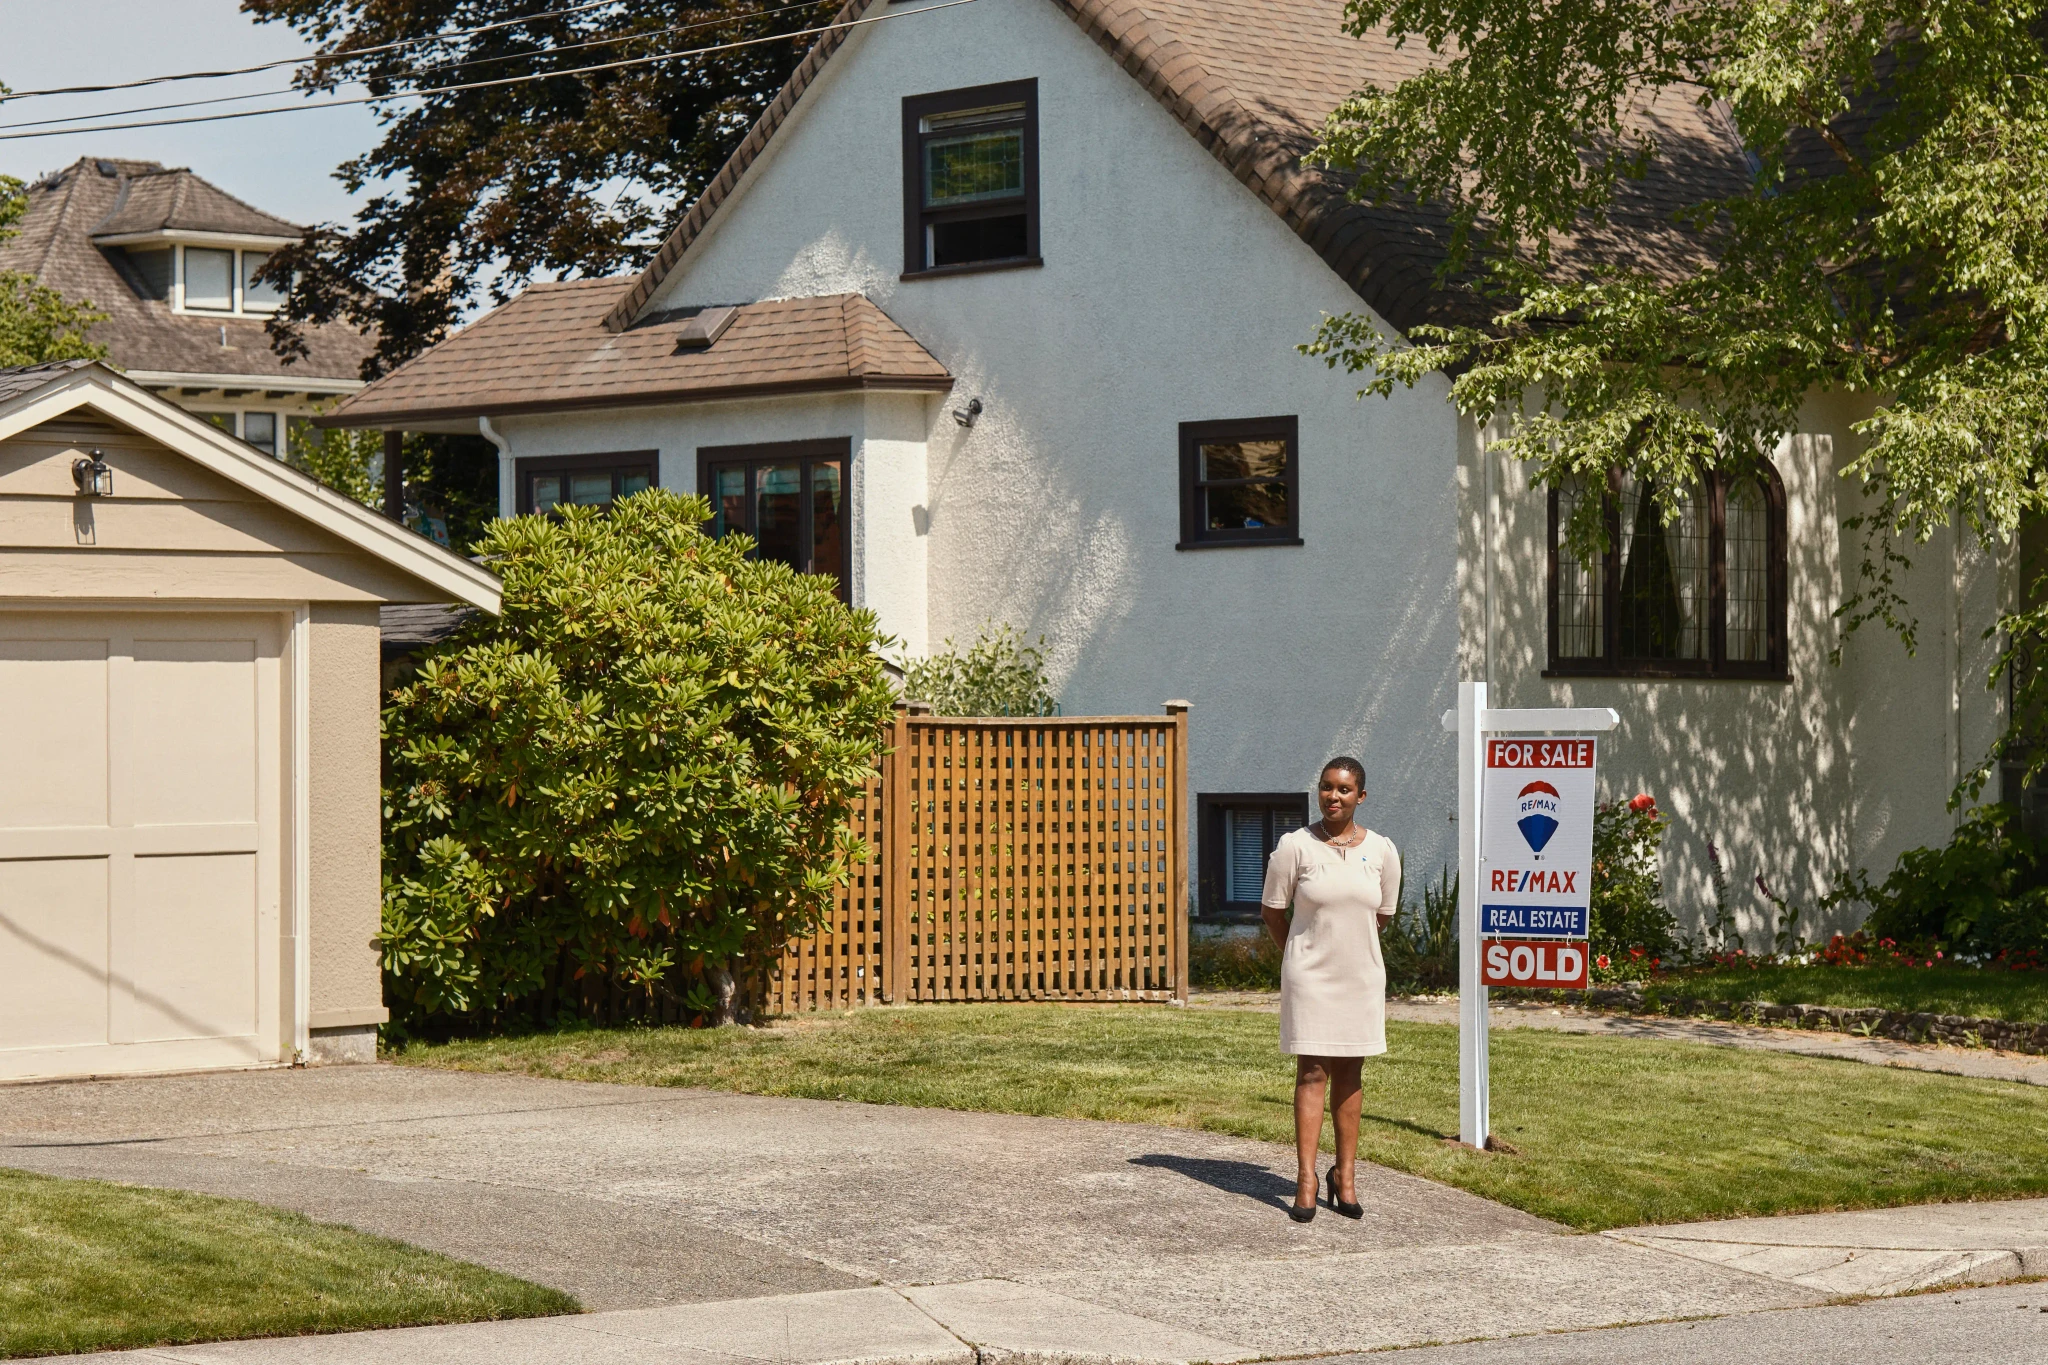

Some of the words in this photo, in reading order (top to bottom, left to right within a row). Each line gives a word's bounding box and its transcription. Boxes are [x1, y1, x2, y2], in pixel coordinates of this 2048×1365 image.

[1494, 744, 1533, 766] FOR
[1540, 744, 1587, 766] SALE
[1521, 799, 1557, 813] RE/MAX
[1491, 870, 1577, 893] RE/MAX
[1490, 909, 1526, 927] REAL
[1530, 910, 1579, 929] ESTATE
[1486, 945, 1583, 981] SOLD
